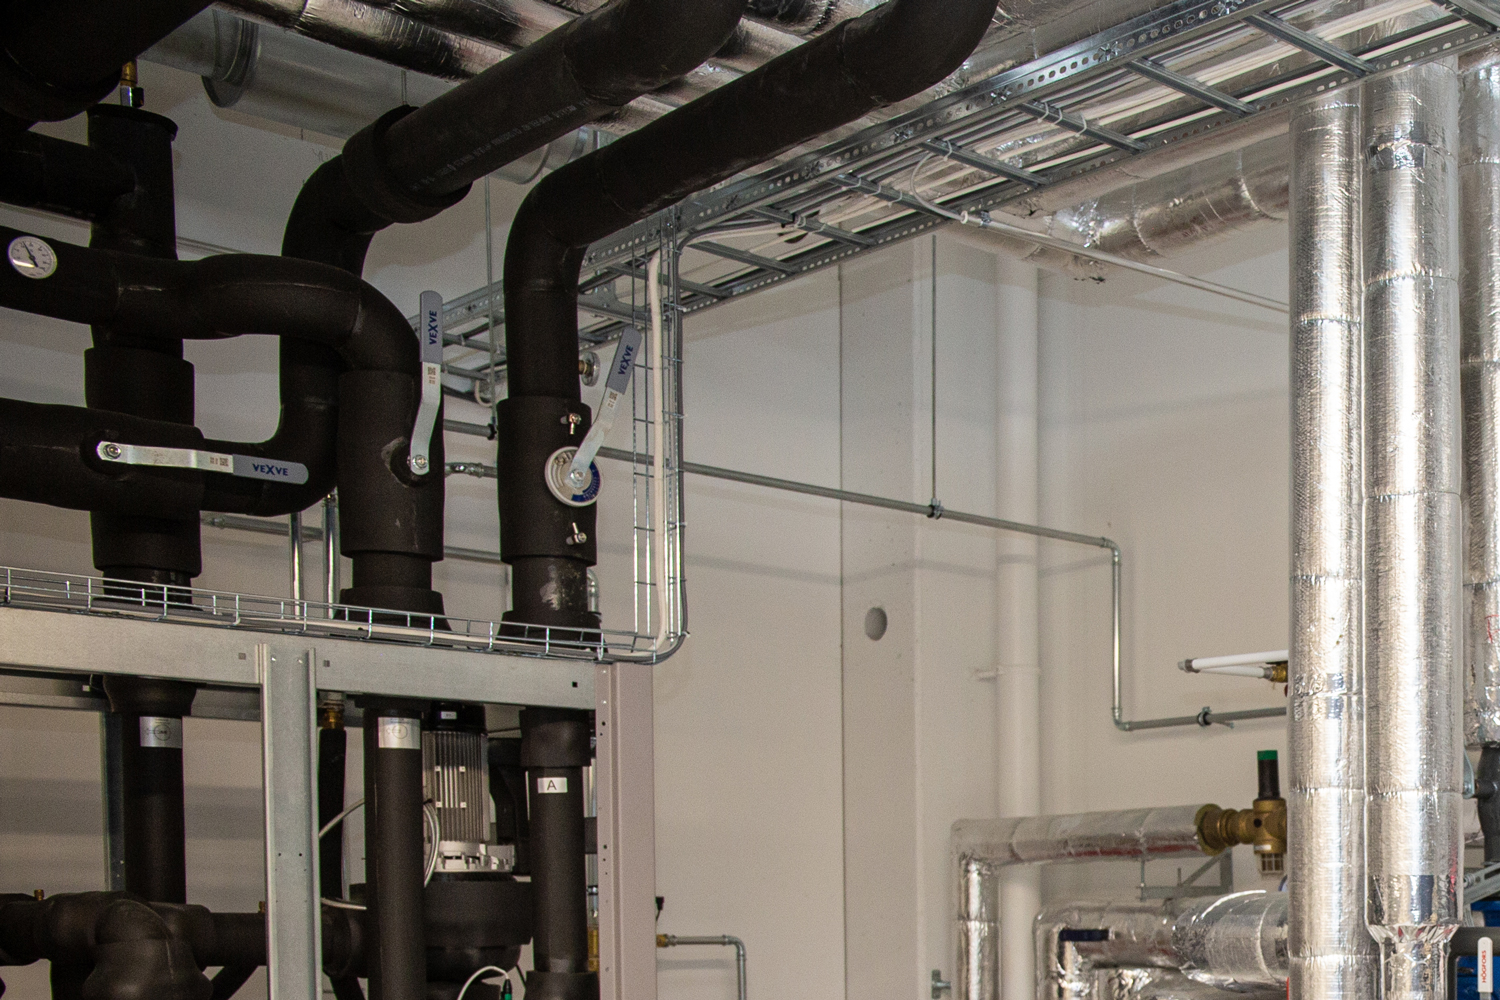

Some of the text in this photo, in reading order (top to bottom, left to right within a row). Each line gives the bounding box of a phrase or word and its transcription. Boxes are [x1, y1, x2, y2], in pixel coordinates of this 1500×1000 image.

[429, 310, 438, 345] VEXVE
[617, 344, 634, 376] VEXVE
[252, 463, 289, 476] VEXVE
[547, 779, 557, 791] A
